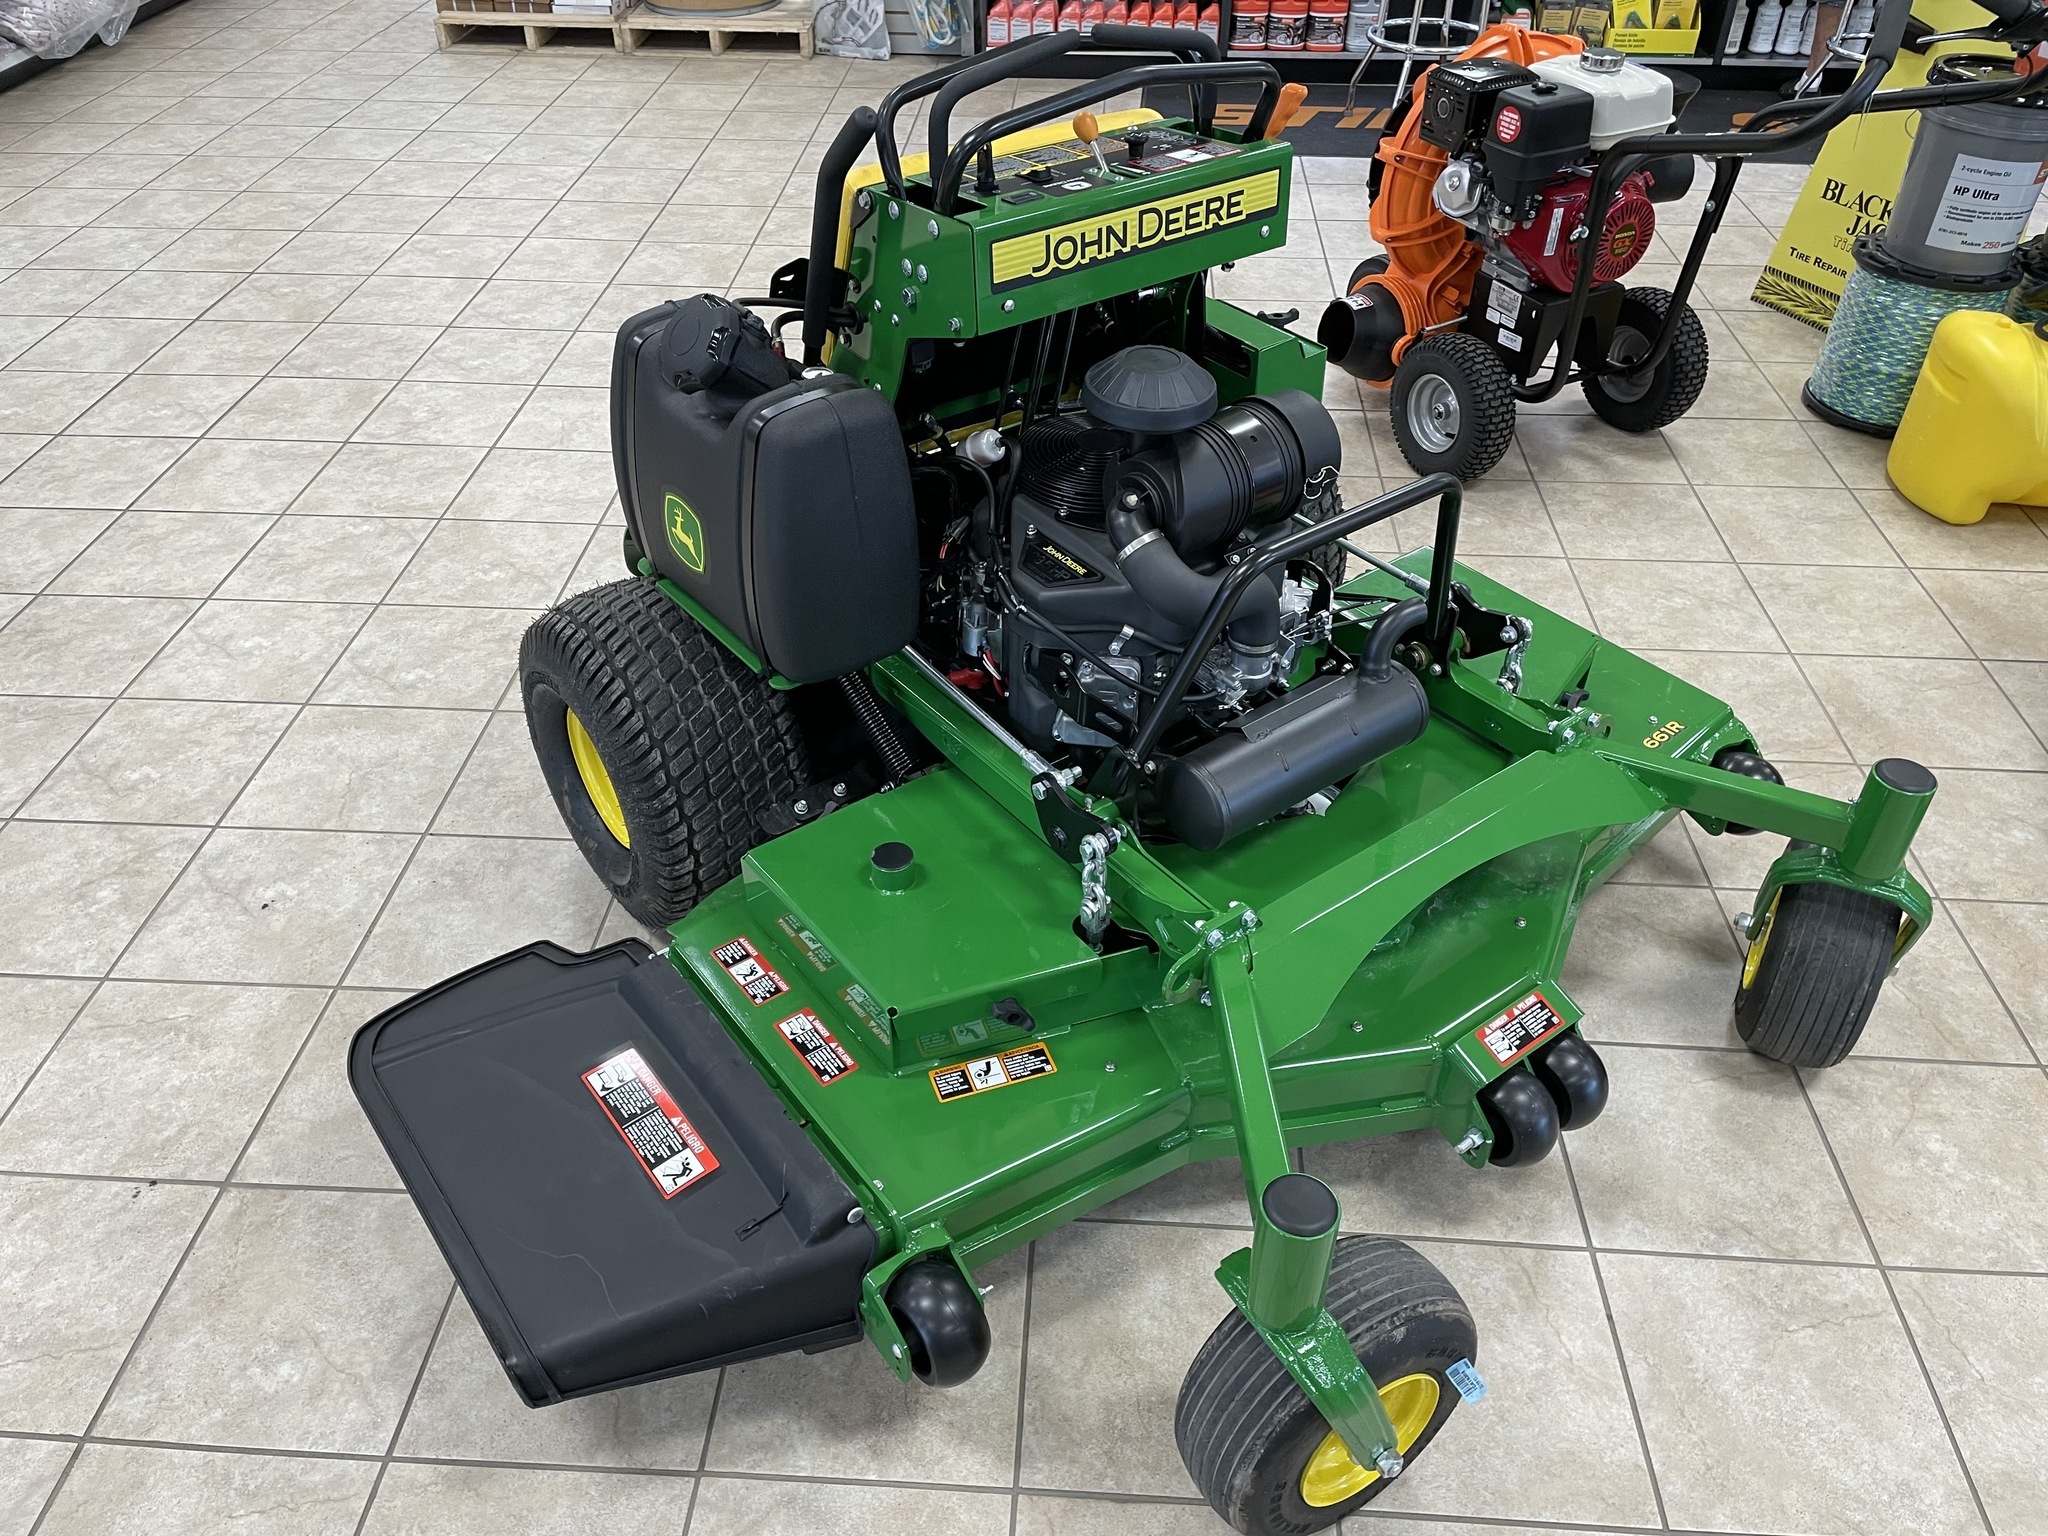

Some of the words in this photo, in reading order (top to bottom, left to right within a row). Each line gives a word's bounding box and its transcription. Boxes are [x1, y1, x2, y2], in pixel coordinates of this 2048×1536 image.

[1961, 165, 1983, 174] 2-cycle
[1983, 169, 2003, 177] Engine
[1953, 185, 1970, 197] HP
[1972, 188, 2000, 201] Ultra
[1031, 219, 1129, 275] JOHN
[1138, 188, 1245, 244] DEERE
[1845, 214, 1888, 237] JAC
[1982, 241, 2001, 249] 250
[1790, 246, 1811, 264] TIRE
[1812, 256, 1848, 279] REPAIR
[1043, 546, 1064, 563] JOHN
[1061, 556, 1088, 576] DEERE
[1642, 720, 1686, 749] 661R
[813, 1019, 831, 1038] DANGER
[836, 1045, 855, 1066] PELIGRO
[636, 1067, 662, 1097] DANGER
[678, 1122, 705, 1155] PELIGRO
